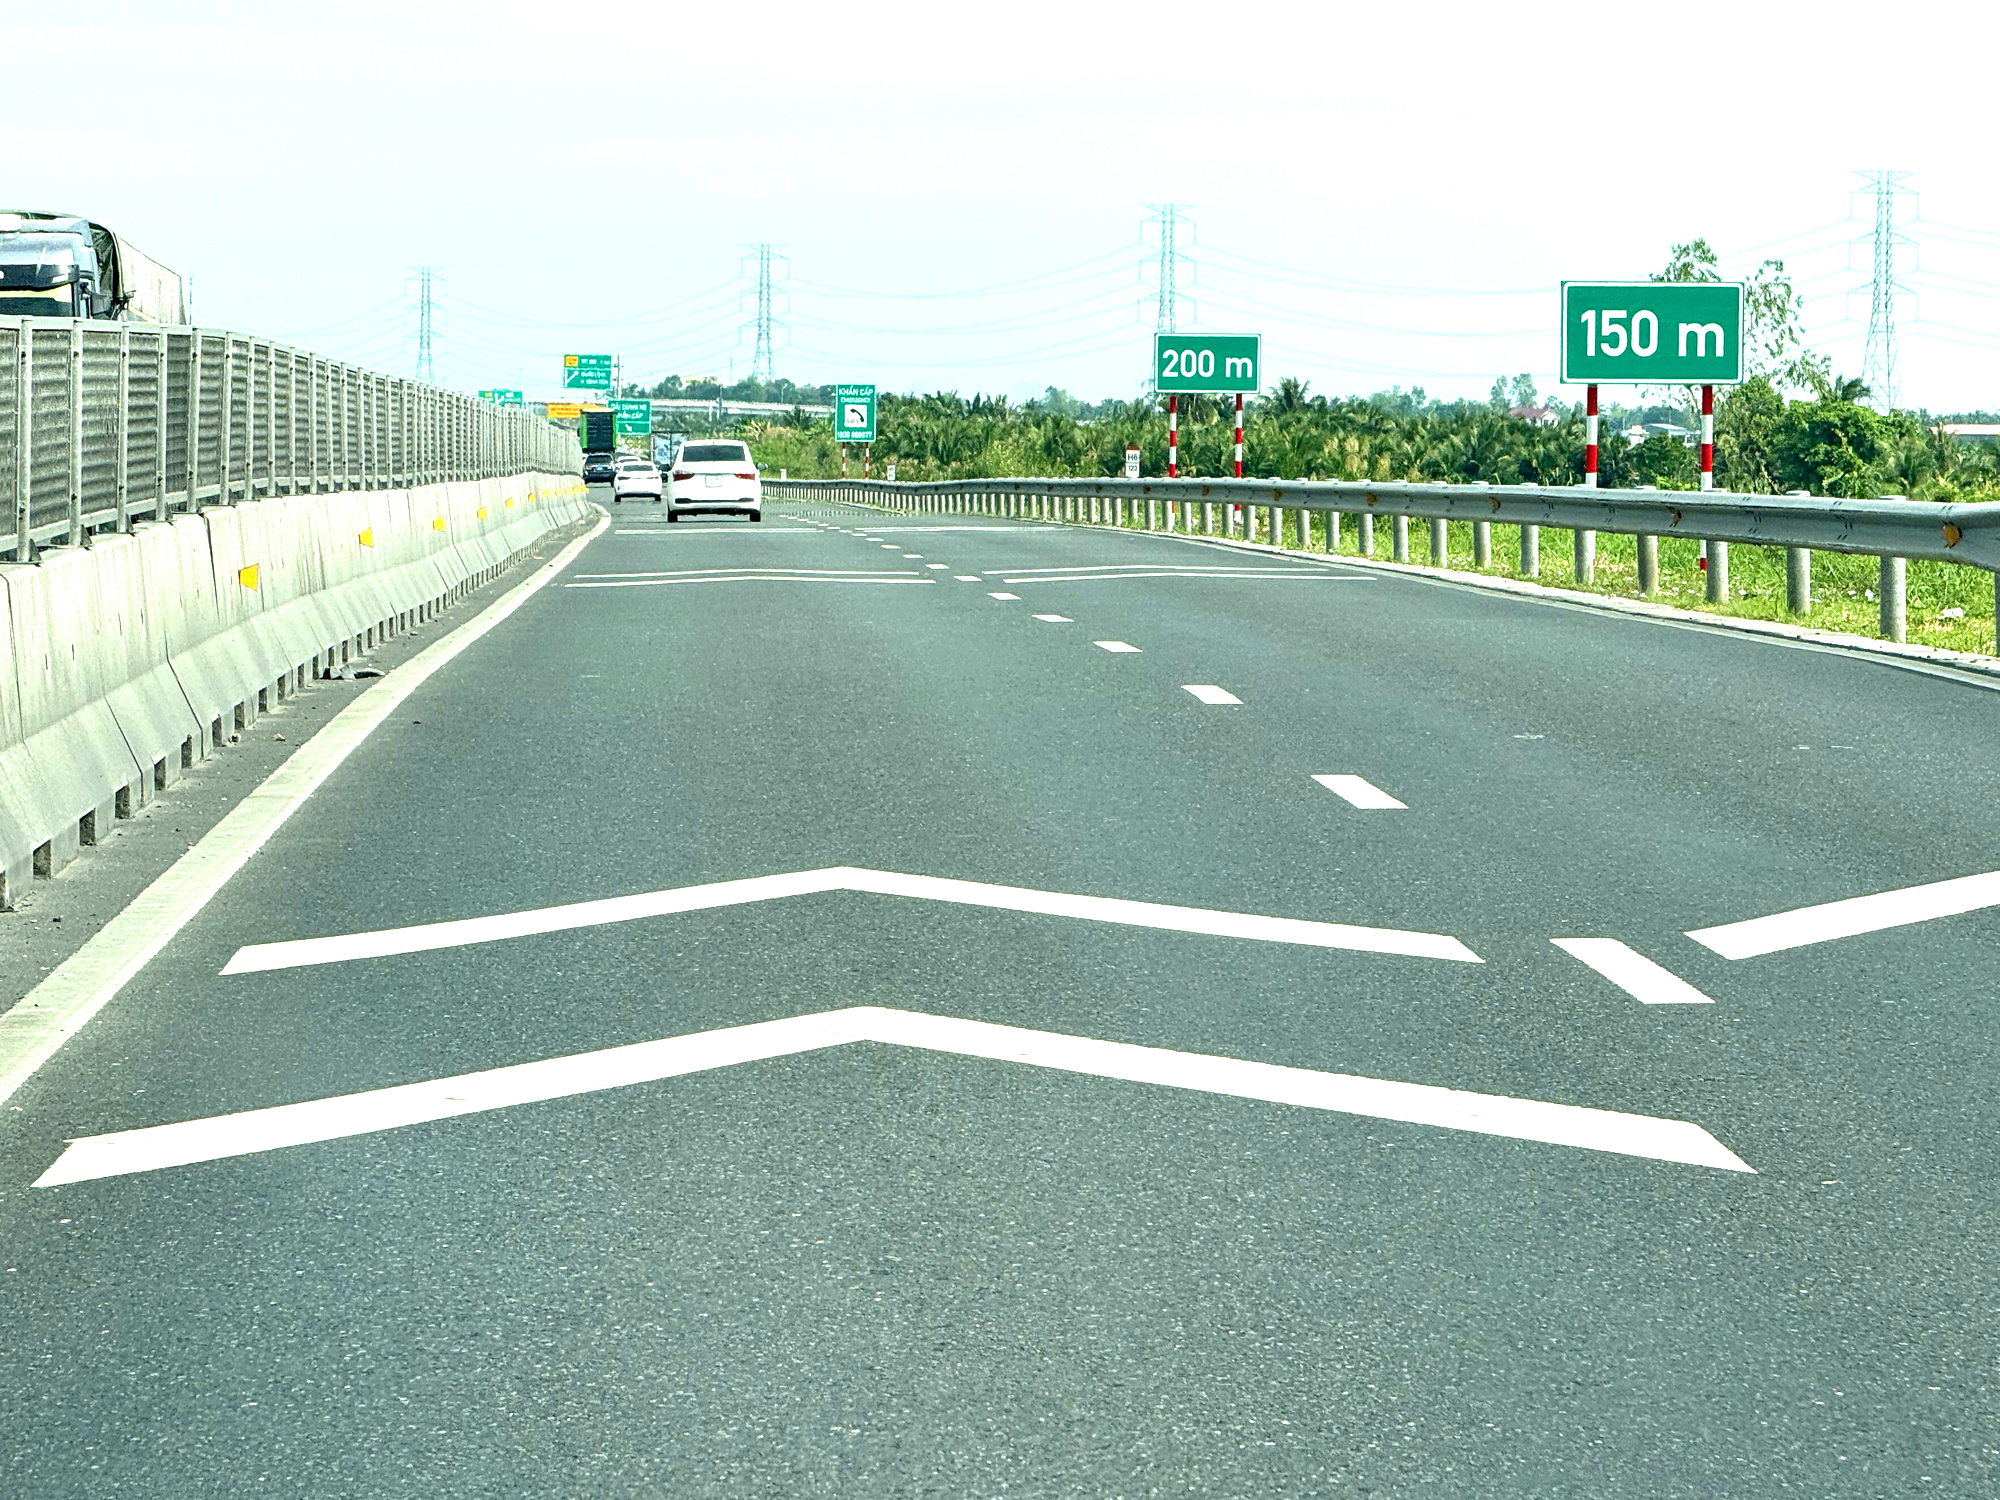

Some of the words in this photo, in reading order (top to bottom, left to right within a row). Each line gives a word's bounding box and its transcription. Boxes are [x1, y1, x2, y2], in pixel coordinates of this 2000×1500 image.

[1581, 310, 1658, 357] 150
[1678, 322, 1725, 357] m
[1162, 349, 1215, 378] 200
[1225, 357, 1253, 378] m
[1127, 453, 1138, 461] H6
